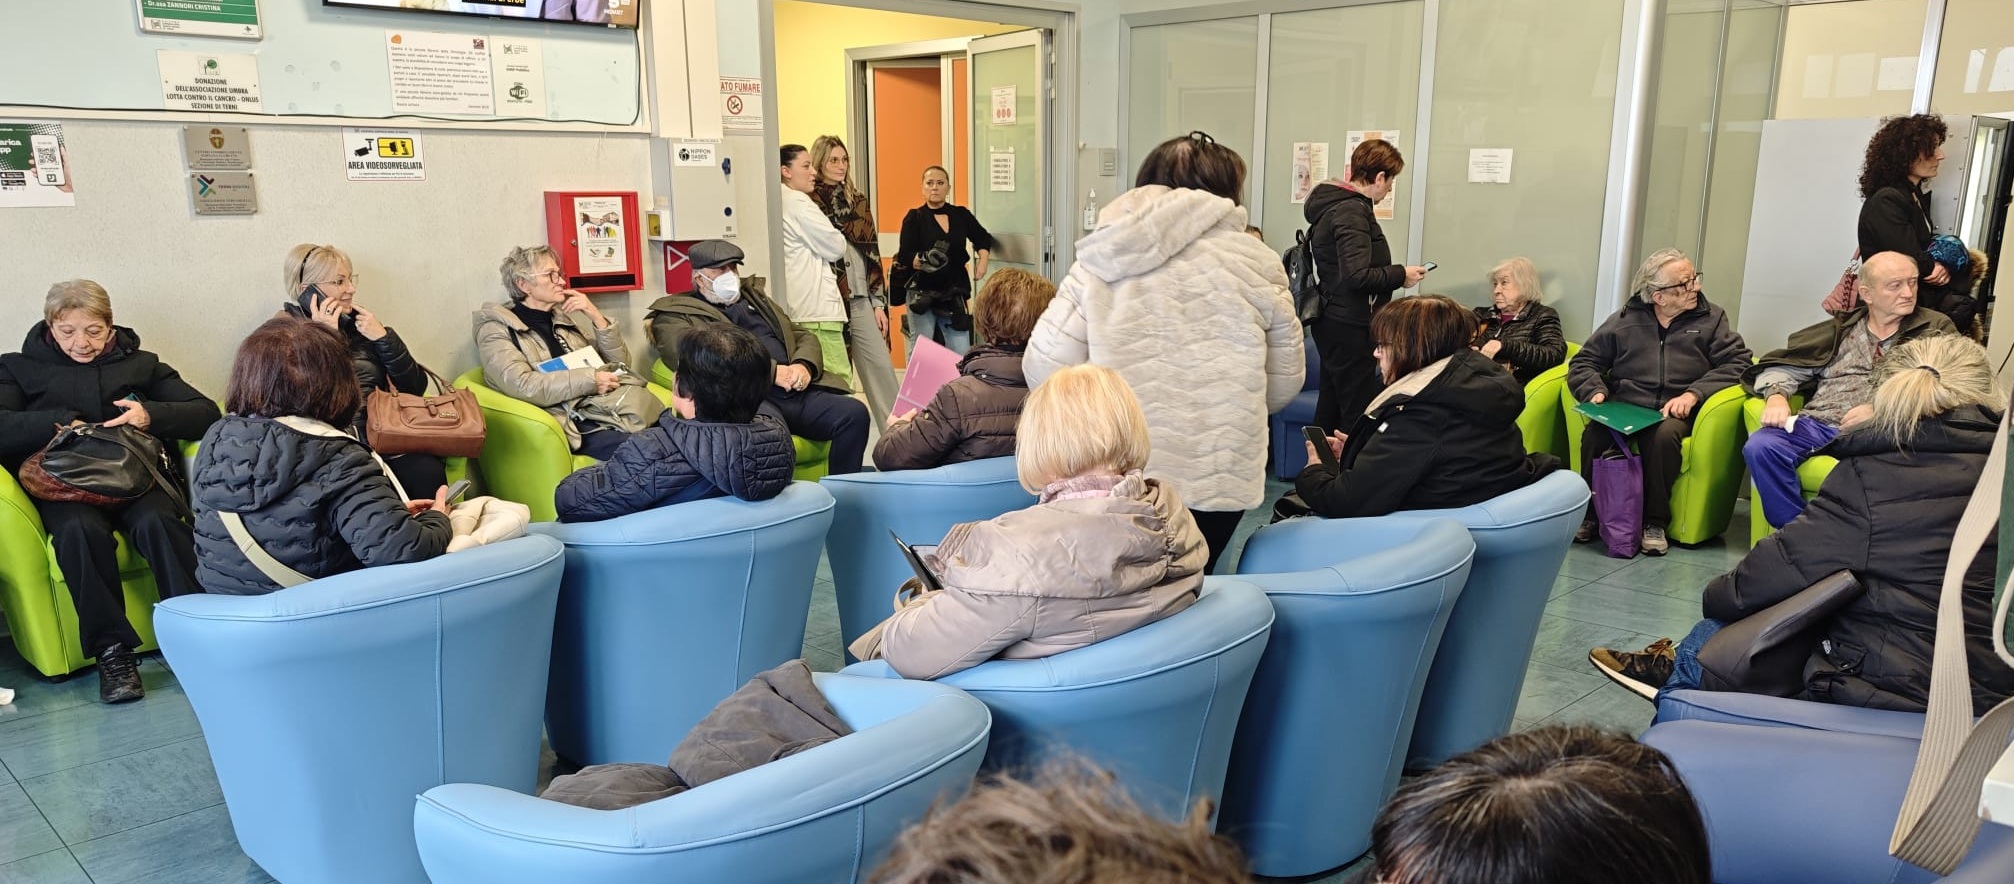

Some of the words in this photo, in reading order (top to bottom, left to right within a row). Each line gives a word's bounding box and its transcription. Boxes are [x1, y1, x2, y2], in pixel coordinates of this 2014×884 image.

[175, 85, 228, 94] DELL'ASSOCIAZIONE
[734, 83, 761, 92] FUMARE
[348, 161, 365, 170] AREA
[365, 161, 423, 170] VIDEOSORVEGLIATA
